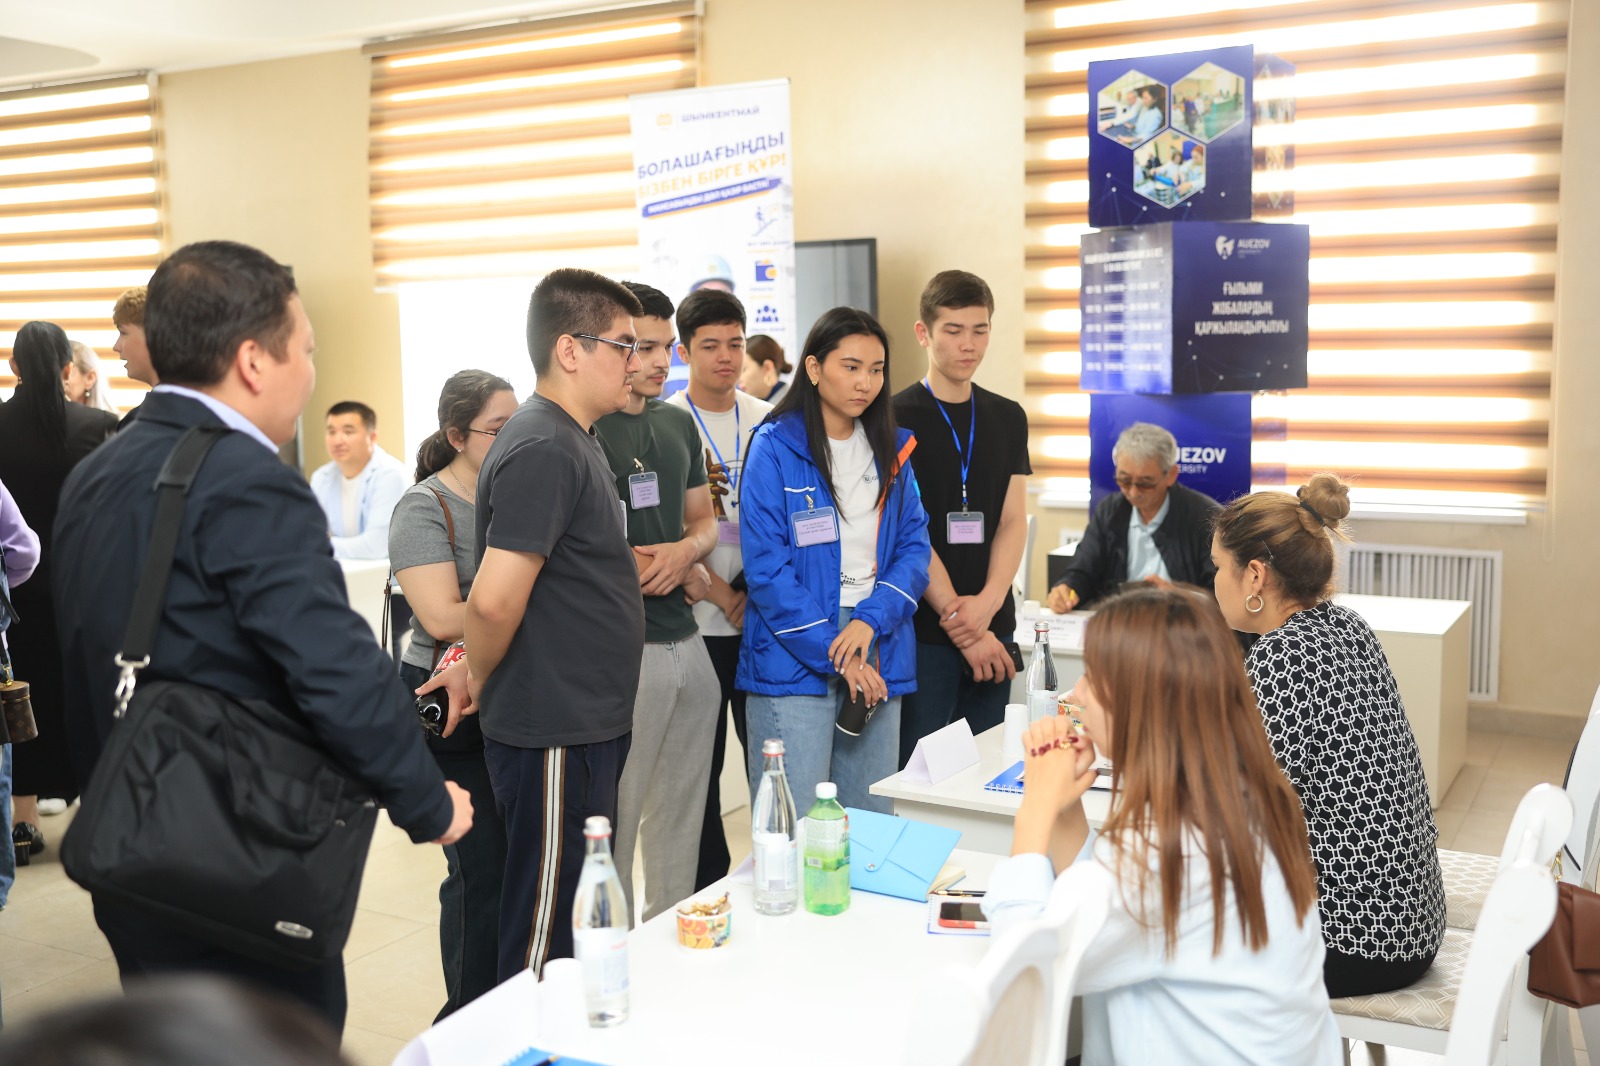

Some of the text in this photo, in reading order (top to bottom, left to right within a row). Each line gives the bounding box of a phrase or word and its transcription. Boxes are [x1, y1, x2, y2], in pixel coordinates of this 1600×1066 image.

[638, 132, 784, 178] БОЛАШАҒЫҢДЫ
[638, 176, 692, 198] БІЗБЕН
[698, 164, 742, 184] БІРГЕ
[1237, 238, 1271, 249] AUEZOV
